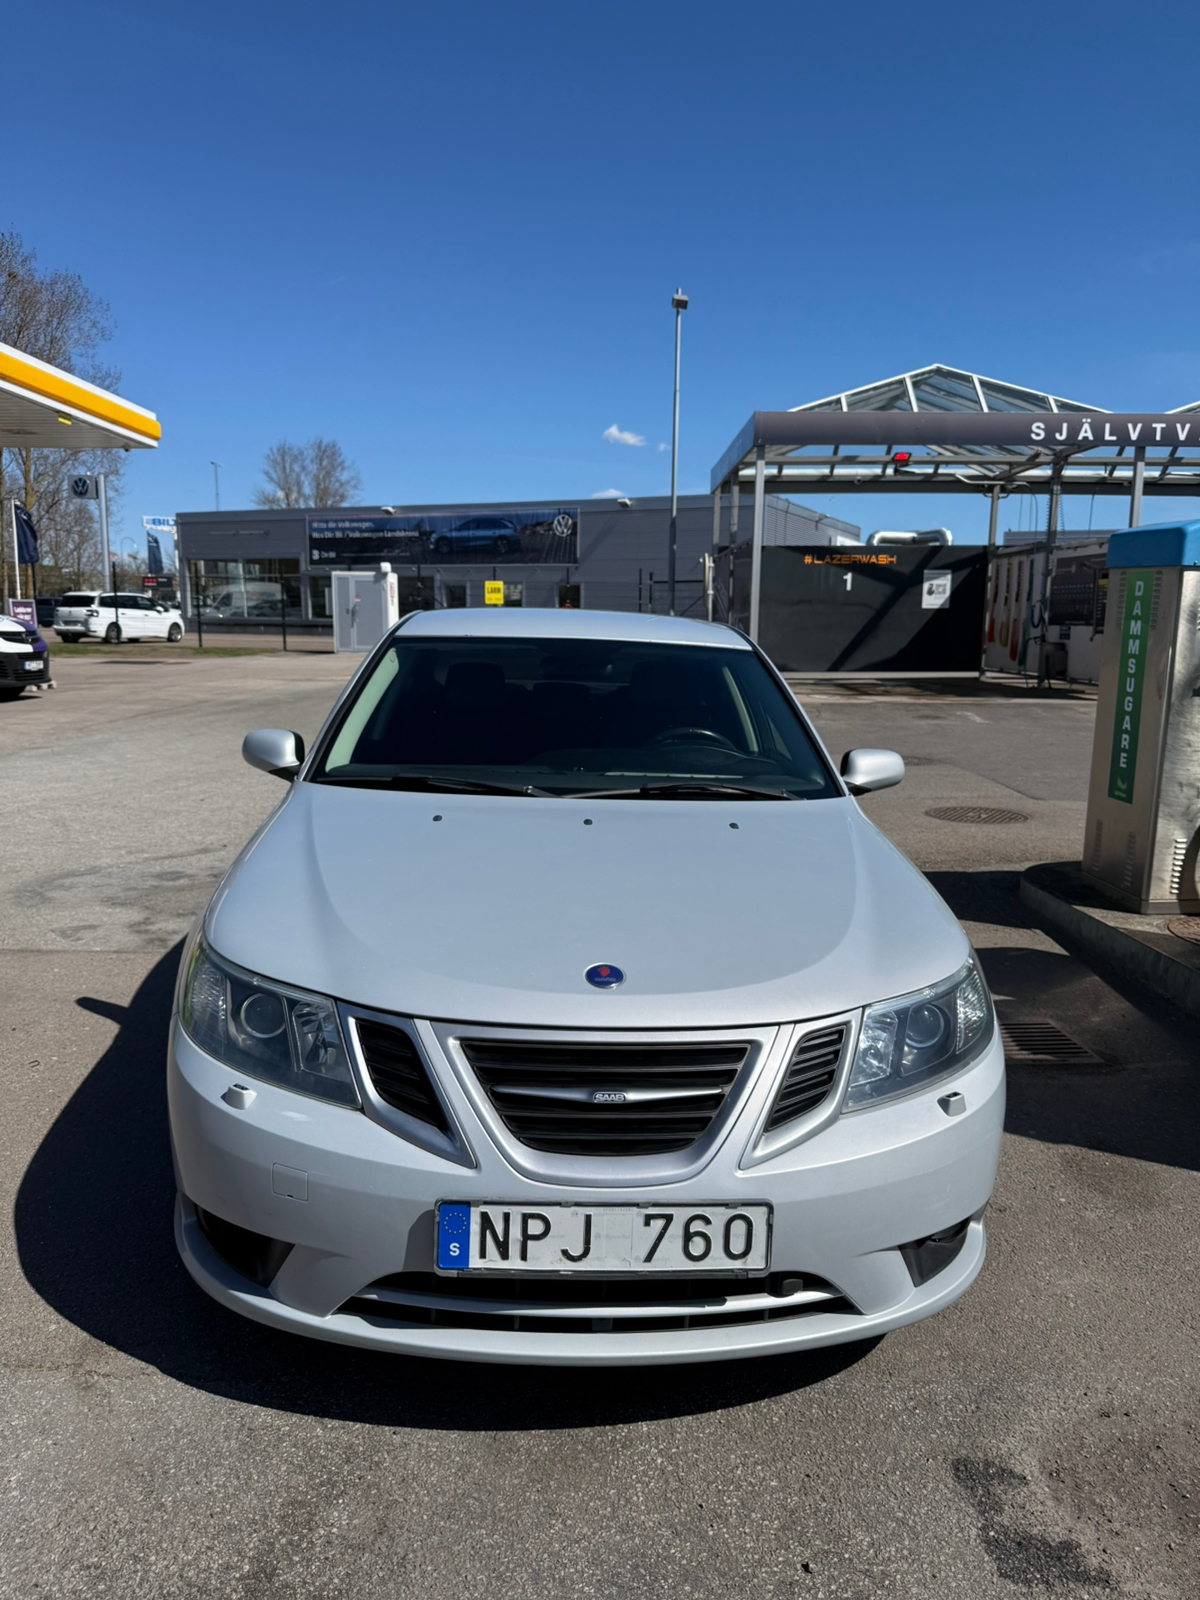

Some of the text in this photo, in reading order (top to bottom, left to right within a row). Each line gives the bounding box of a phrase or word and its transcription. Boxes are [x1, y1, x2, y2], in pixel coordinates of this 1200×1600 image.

[1031, 418, 1200, 441] SJÄLVTV
[804, 554, 897, 565] #LAZERWASH
[843, 572, 853, 591] 1
[1119, 581, 1145, 769] DAMMSUGARE
[595, 1093, 625, 1102] SAAB
[479, 1210, 754, 1262] NPJ 760
[449, 1242, 460, 1256] S
